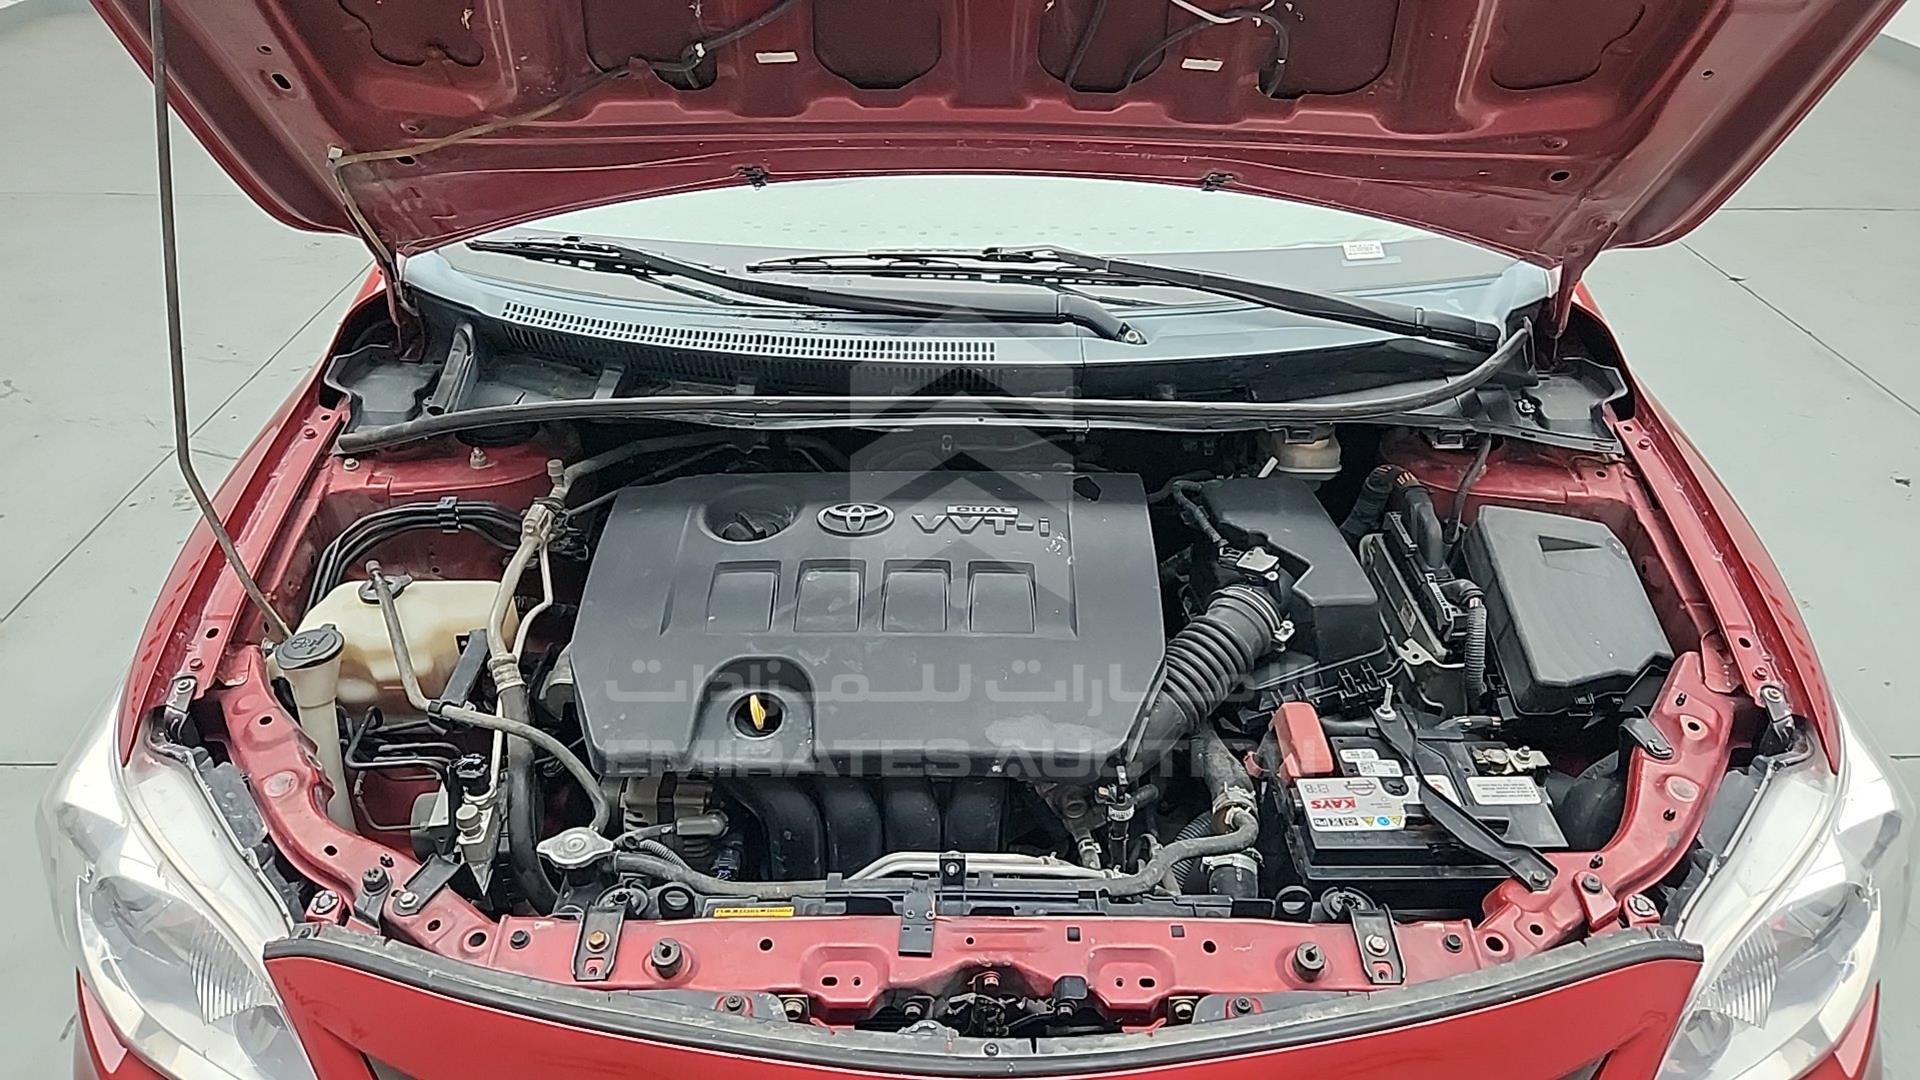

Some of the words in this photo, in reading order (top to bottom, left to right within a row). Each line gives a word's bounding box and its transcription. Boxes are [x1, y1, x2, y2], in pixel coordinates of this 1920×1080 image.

[956, 506, 1013, 514] DUAL
[911, 514, 1050, 537] VVT-i
[1311, 799, 1357, 809] KAYS
